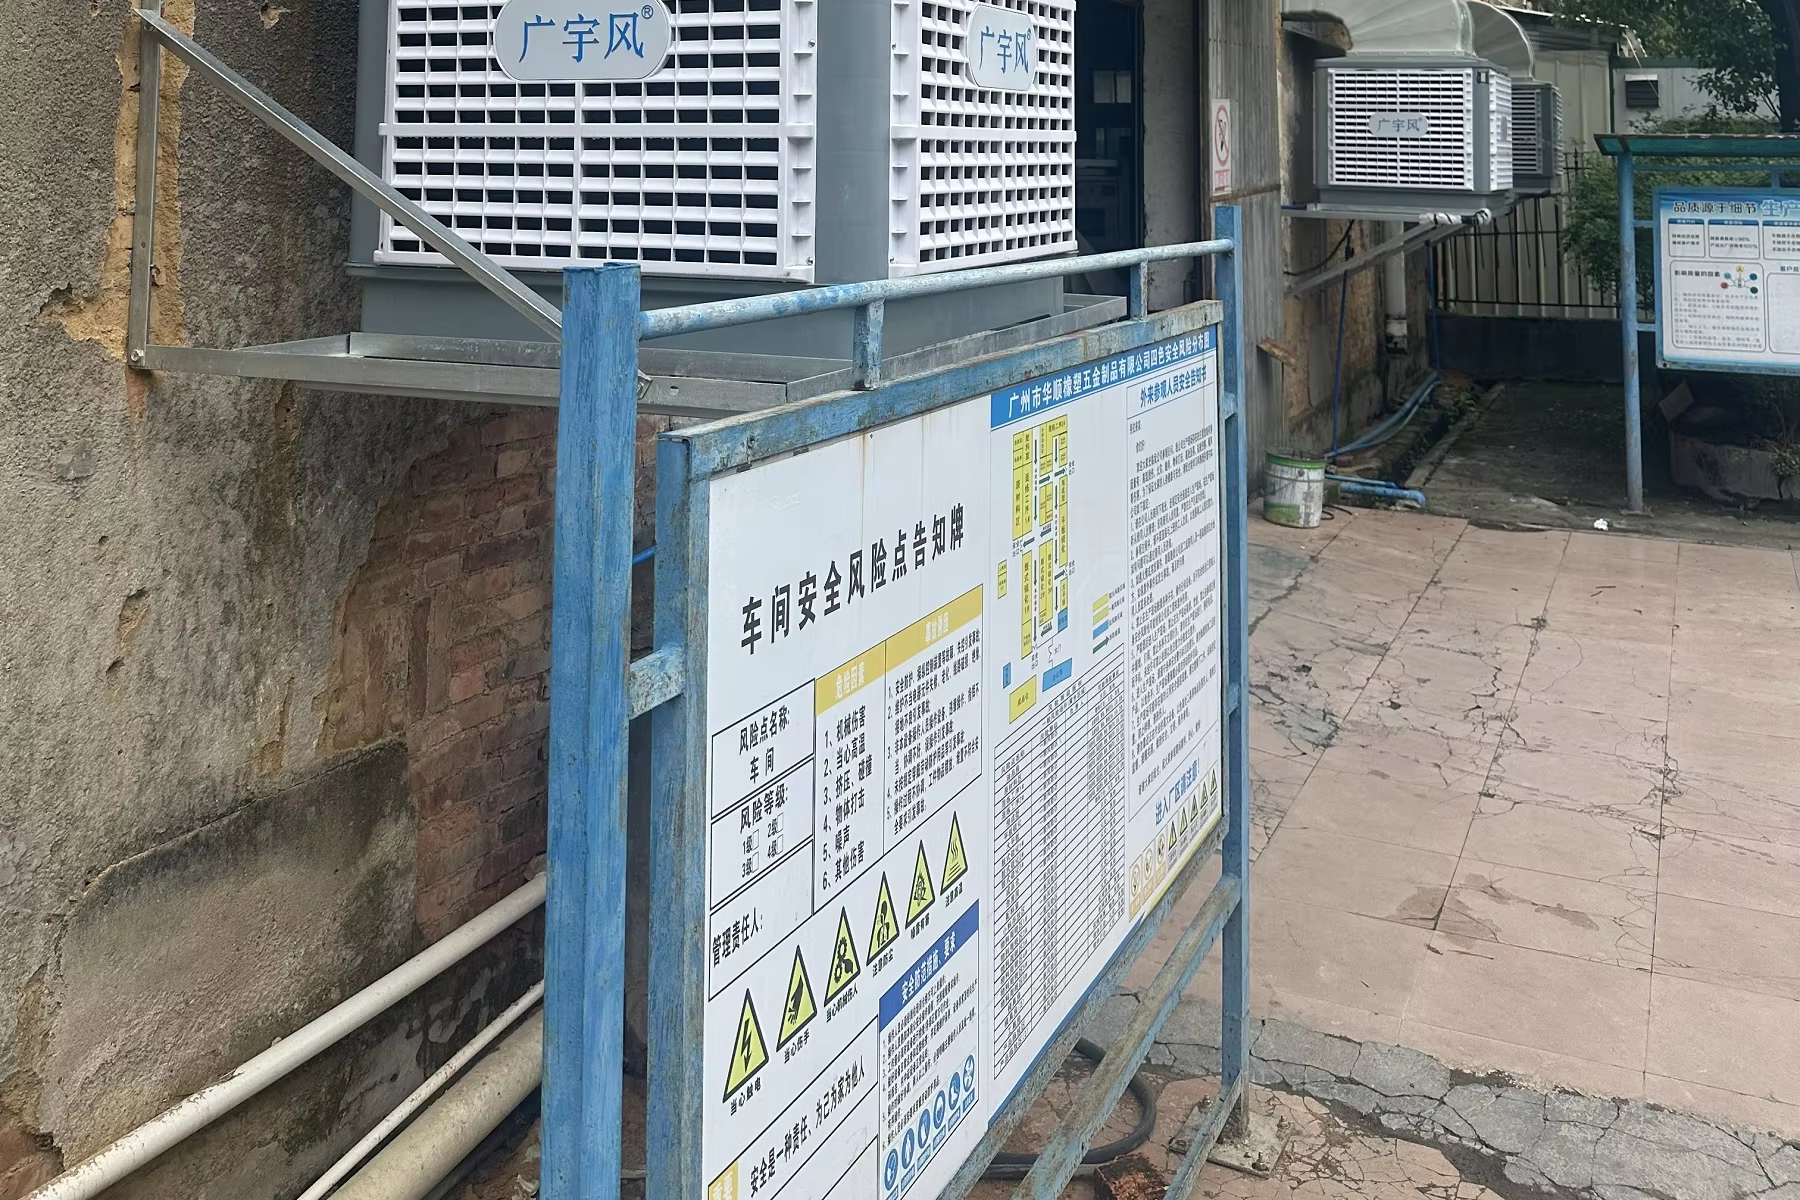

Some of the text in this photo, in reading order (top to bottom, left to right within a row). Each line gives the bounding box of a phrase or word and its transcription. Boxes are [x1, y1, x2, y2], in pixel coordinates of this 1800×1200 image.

[1673, 200, 1757, 214] 品质源于细节
[741, 503, 964, 655] 车间安全风险点告知牌
[739, 704, 790, 755] 风险点名称:
[750, 747, 775, 784] 车间
[740, 783, 789, 834] 风险等级:
[712, 907, 763, 969] 管理责任人:
[872, 948, 894, 978] 注意防尘
[826, 989, 858, 1023] 当心机械伤人
[784, 1030, 810, 1064] 当心伤手
[730, 1081, 762, 1117] 当心触电
